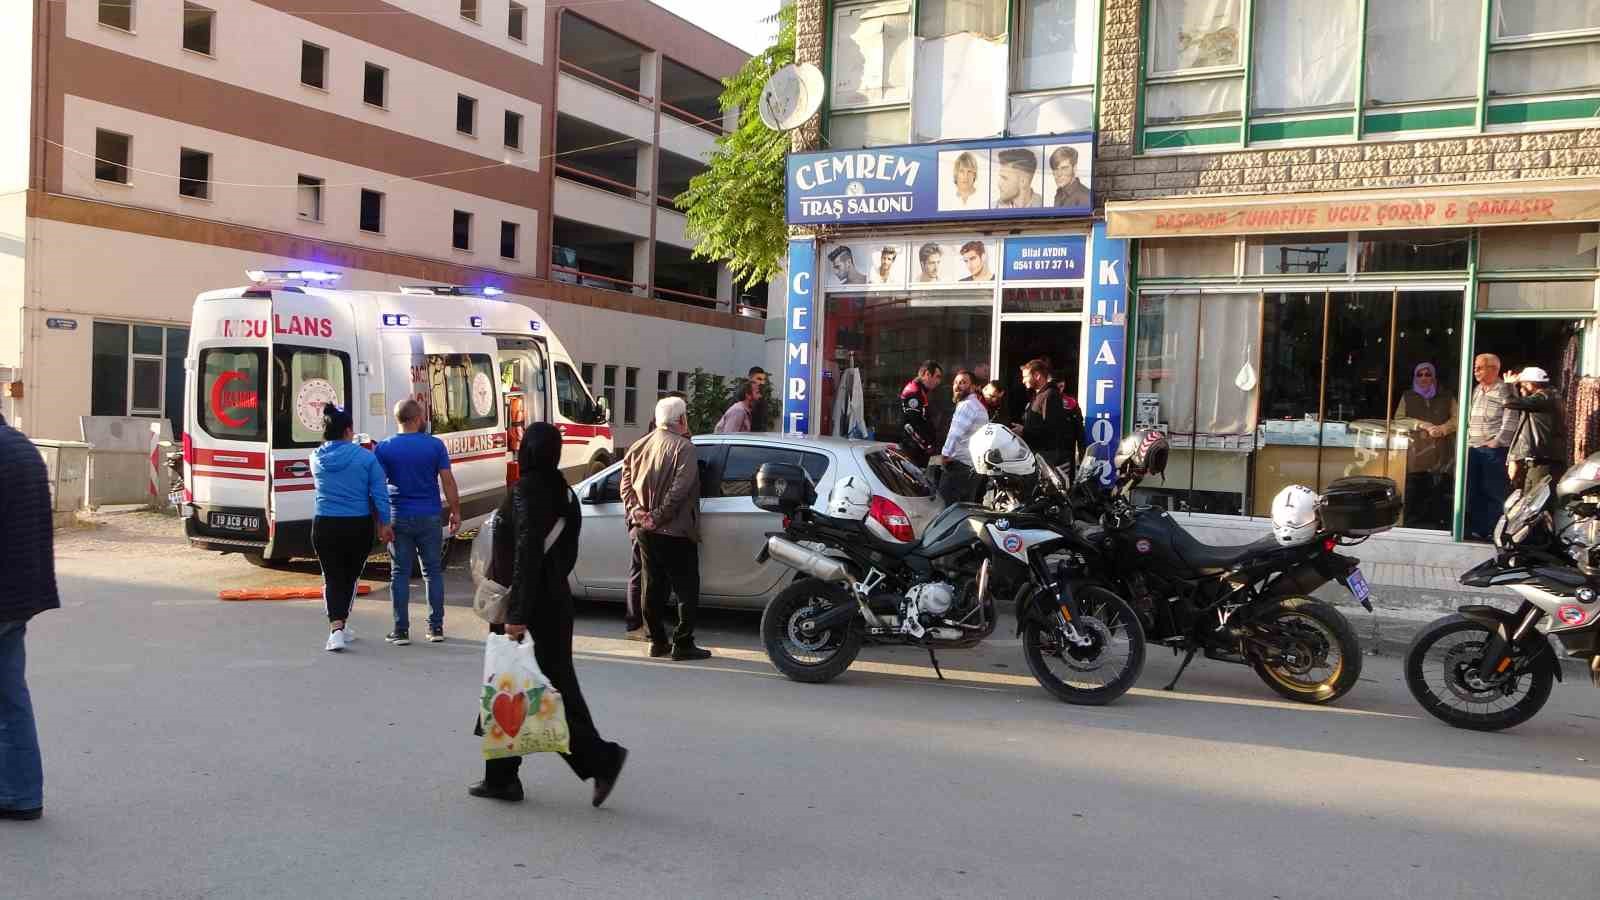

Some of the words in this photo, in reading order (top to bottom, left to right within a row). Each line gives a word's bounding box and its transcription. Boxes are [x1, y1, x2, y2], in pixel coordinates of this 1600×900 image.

[795, 154, 920, 190] CEMREM
[800, 199, 843, 219] TRAŞ
[848, 196, 913, 214] SALONU
[1327, 203, 1371, 223] UCUZ
[1375, 203, 1436, 225] ÇORAP
[1444, 203, 1457, 219] &
[1043, 247, 1067, 257] AYDIN
[1013, 260, 1033, 270] 0541
[1035, 260, 1050, 269] 617
[1052, 260, 1062, 269] 37
[1065, 260, 1074, 269] 14
[445, 434, 493, 454] MBULANS
